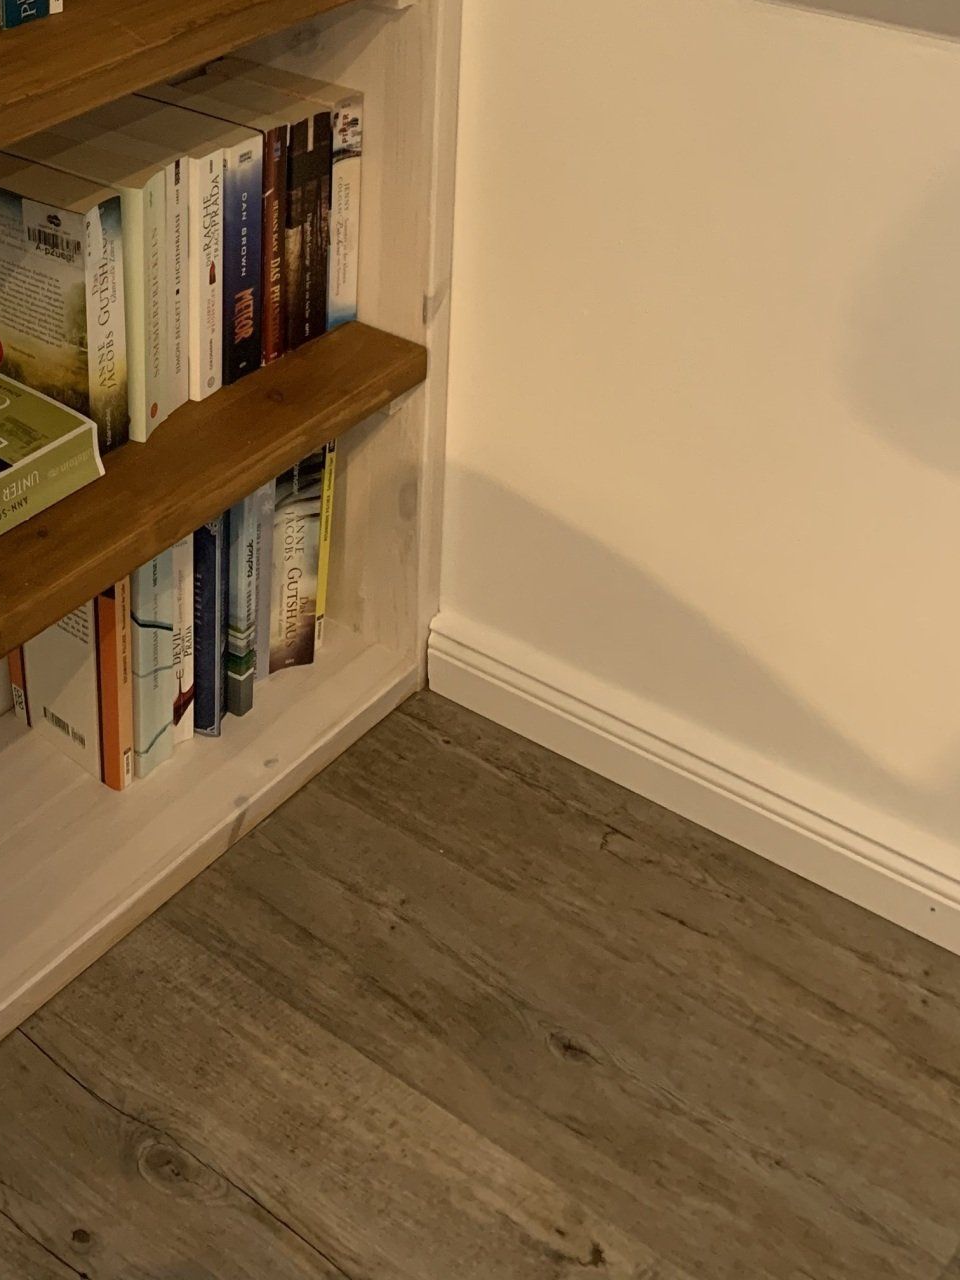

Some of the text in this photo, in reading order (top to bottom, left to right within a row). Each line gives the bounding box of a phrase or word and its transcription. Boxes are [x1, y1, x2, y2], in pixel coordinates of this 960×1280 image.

[210, 174, 220, 229] PRADA
[203, 196, 212, 252] RACHE
[270, 257, 281, 282] DAS
[235, 287, 255, 345] METEOR
[98, 341, 107, 389] ANNE
[105, 330, 117, 389] JACOBS
[3, 470, 40, 502] UNTER
[284, 511, 295, 562] JACOBS
[295, 515, 305, 554] ANNE
[246, 539, 254, 578] tschick
[285, 567, 302, 648] GUTSHAUS
[300, 596, 309, 614] Das
[172, 628, 182, 666] DEVIL
[184, 625, 192, 658] PRADA
